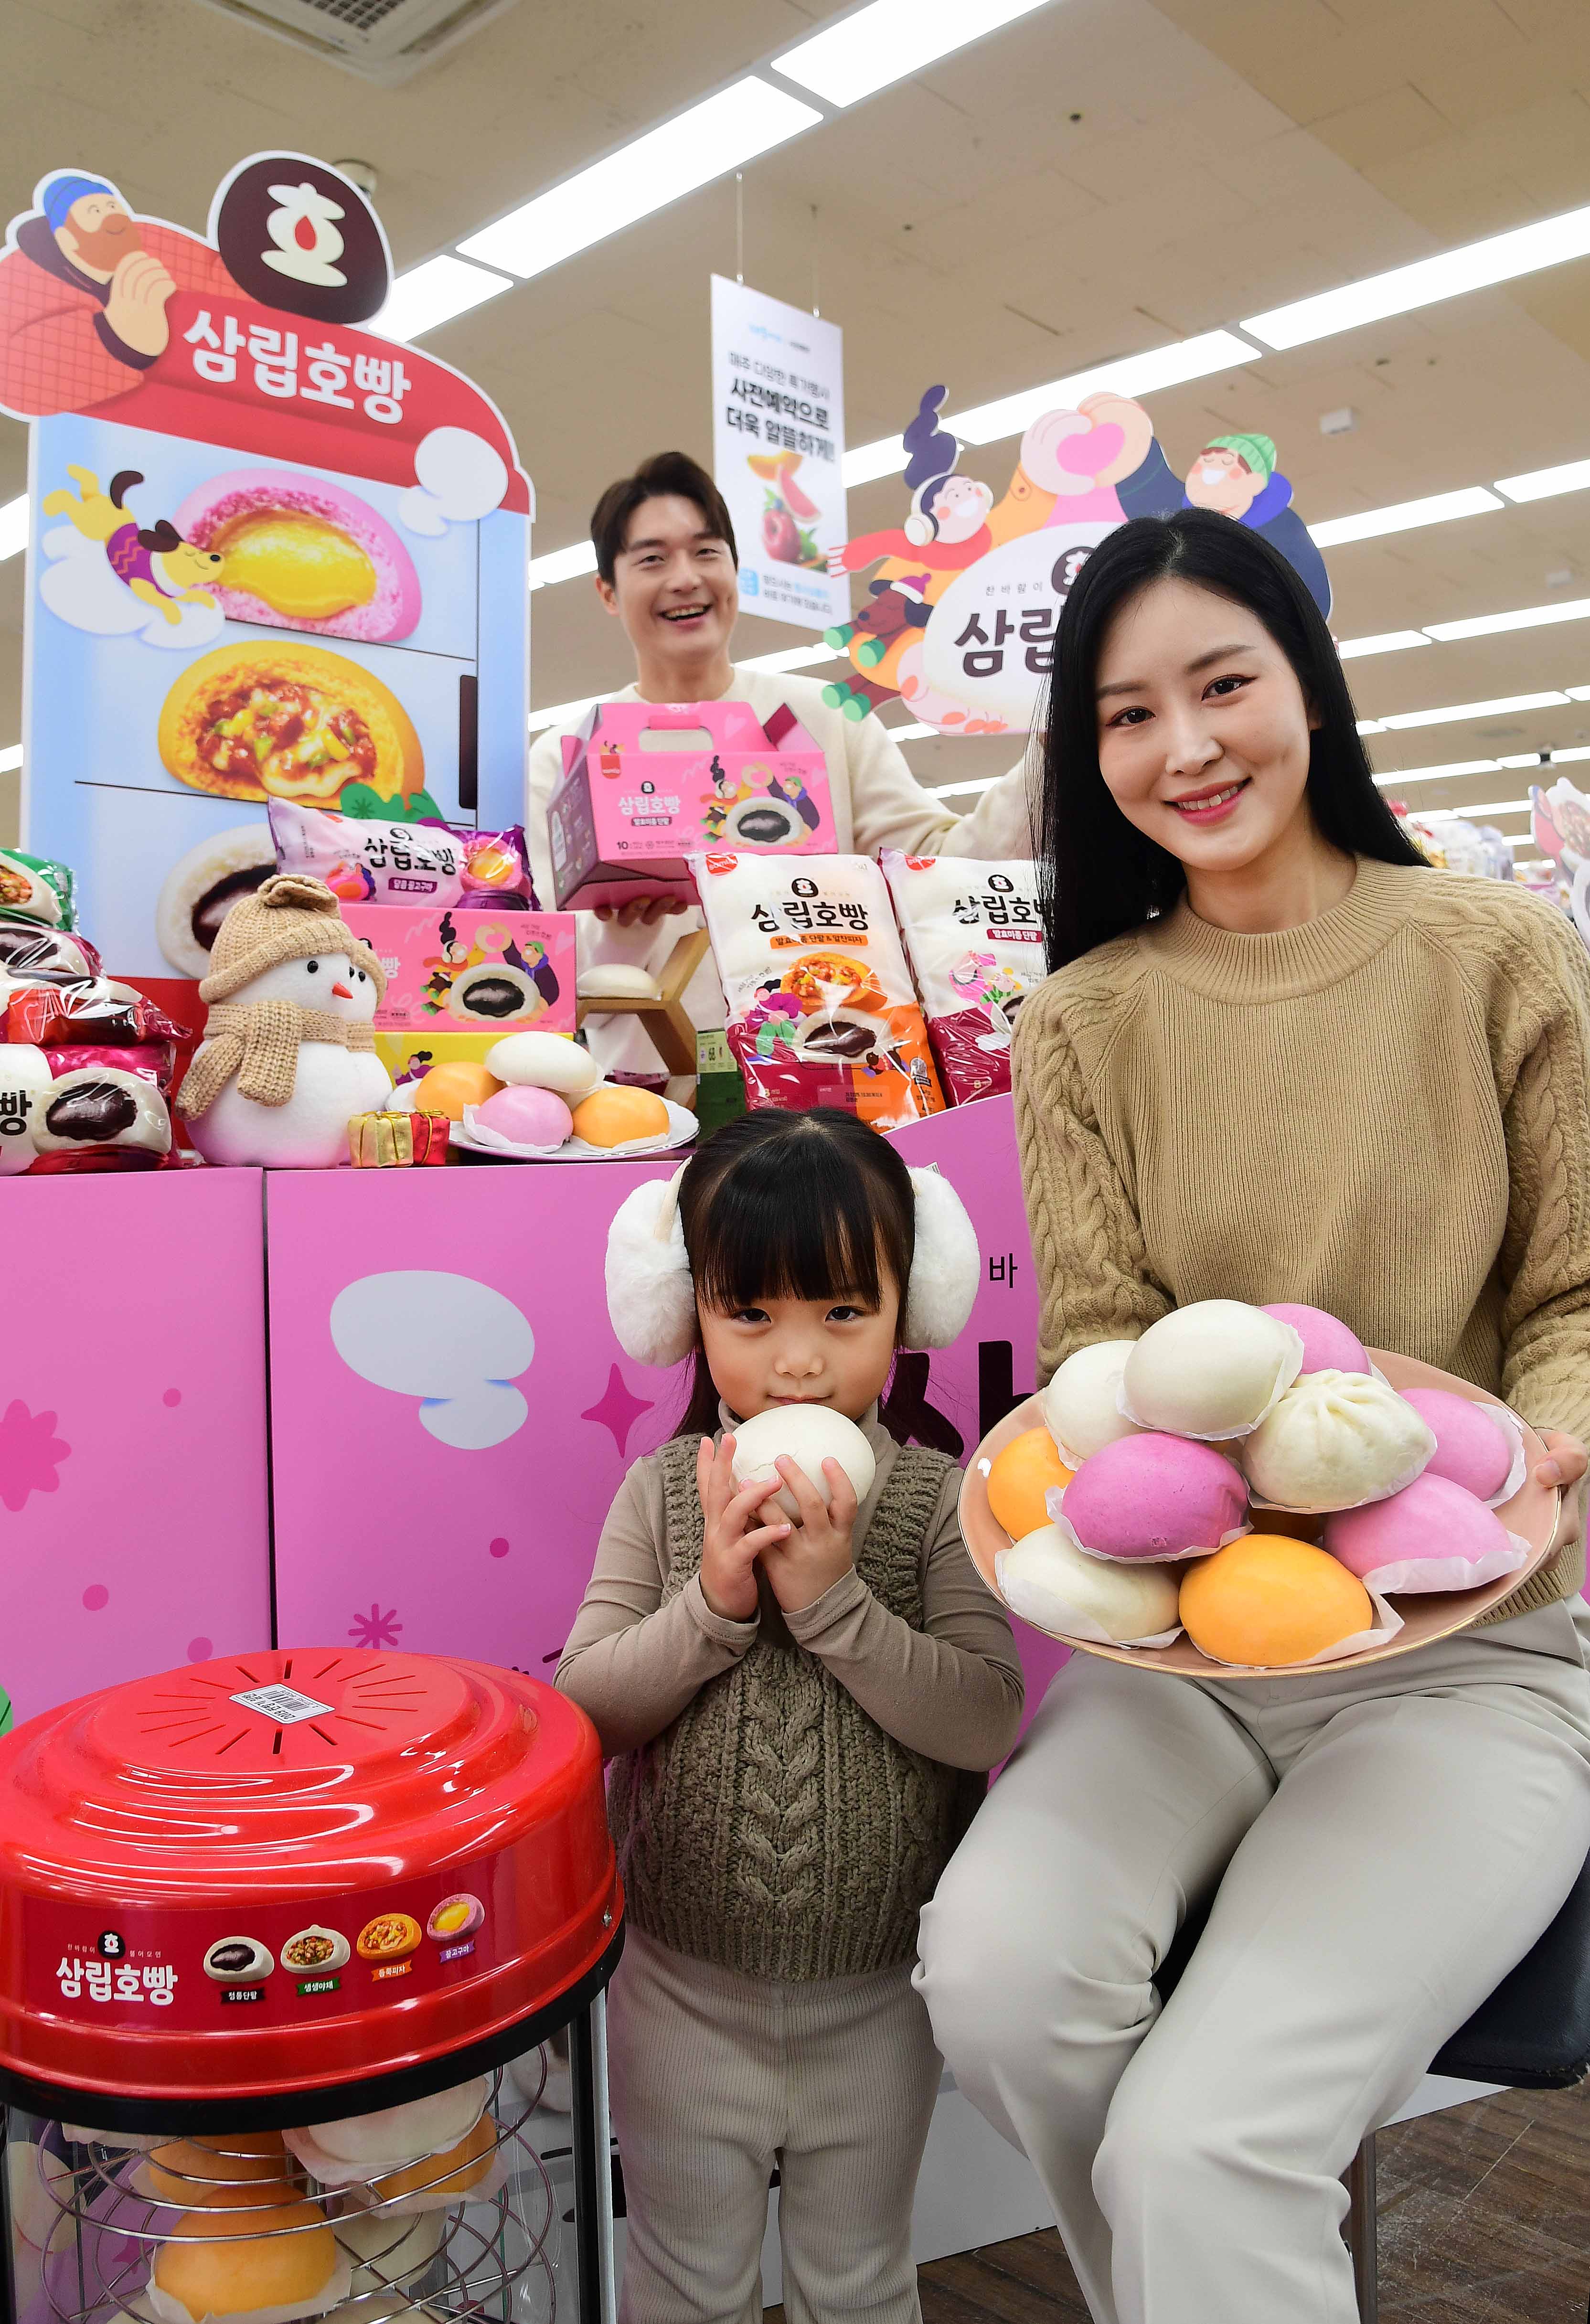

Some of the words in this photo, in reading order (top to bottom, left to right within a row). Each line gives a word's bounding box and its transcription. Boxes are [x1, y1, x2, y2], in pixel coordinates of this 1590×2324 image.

[183, 310, 412, 425] 삼립호빵
[731, 378, 829, 430] 사전예약으로
[727, 406, 759, 437] 더욱
[618, 795, 681, 816] 삼립호빵
[617, 841, 628, 850] 10
[809, 935, 824, 943] 단팥
[832, 935, 863, 944] 알찬피자
[992, 929, 1022, 940] 발효미종
[1022, 931, 1037, 941] 단팥
[274, 1710, 296, 1719] 2019
[56, 1957, 178, 2006] 삼립호빵
[228, 1990, 257, 2000] 정통단팥
[304, 1980, 334, 1992] 생생야채
[445, 1944, 470, 1959] 꿀고구마
